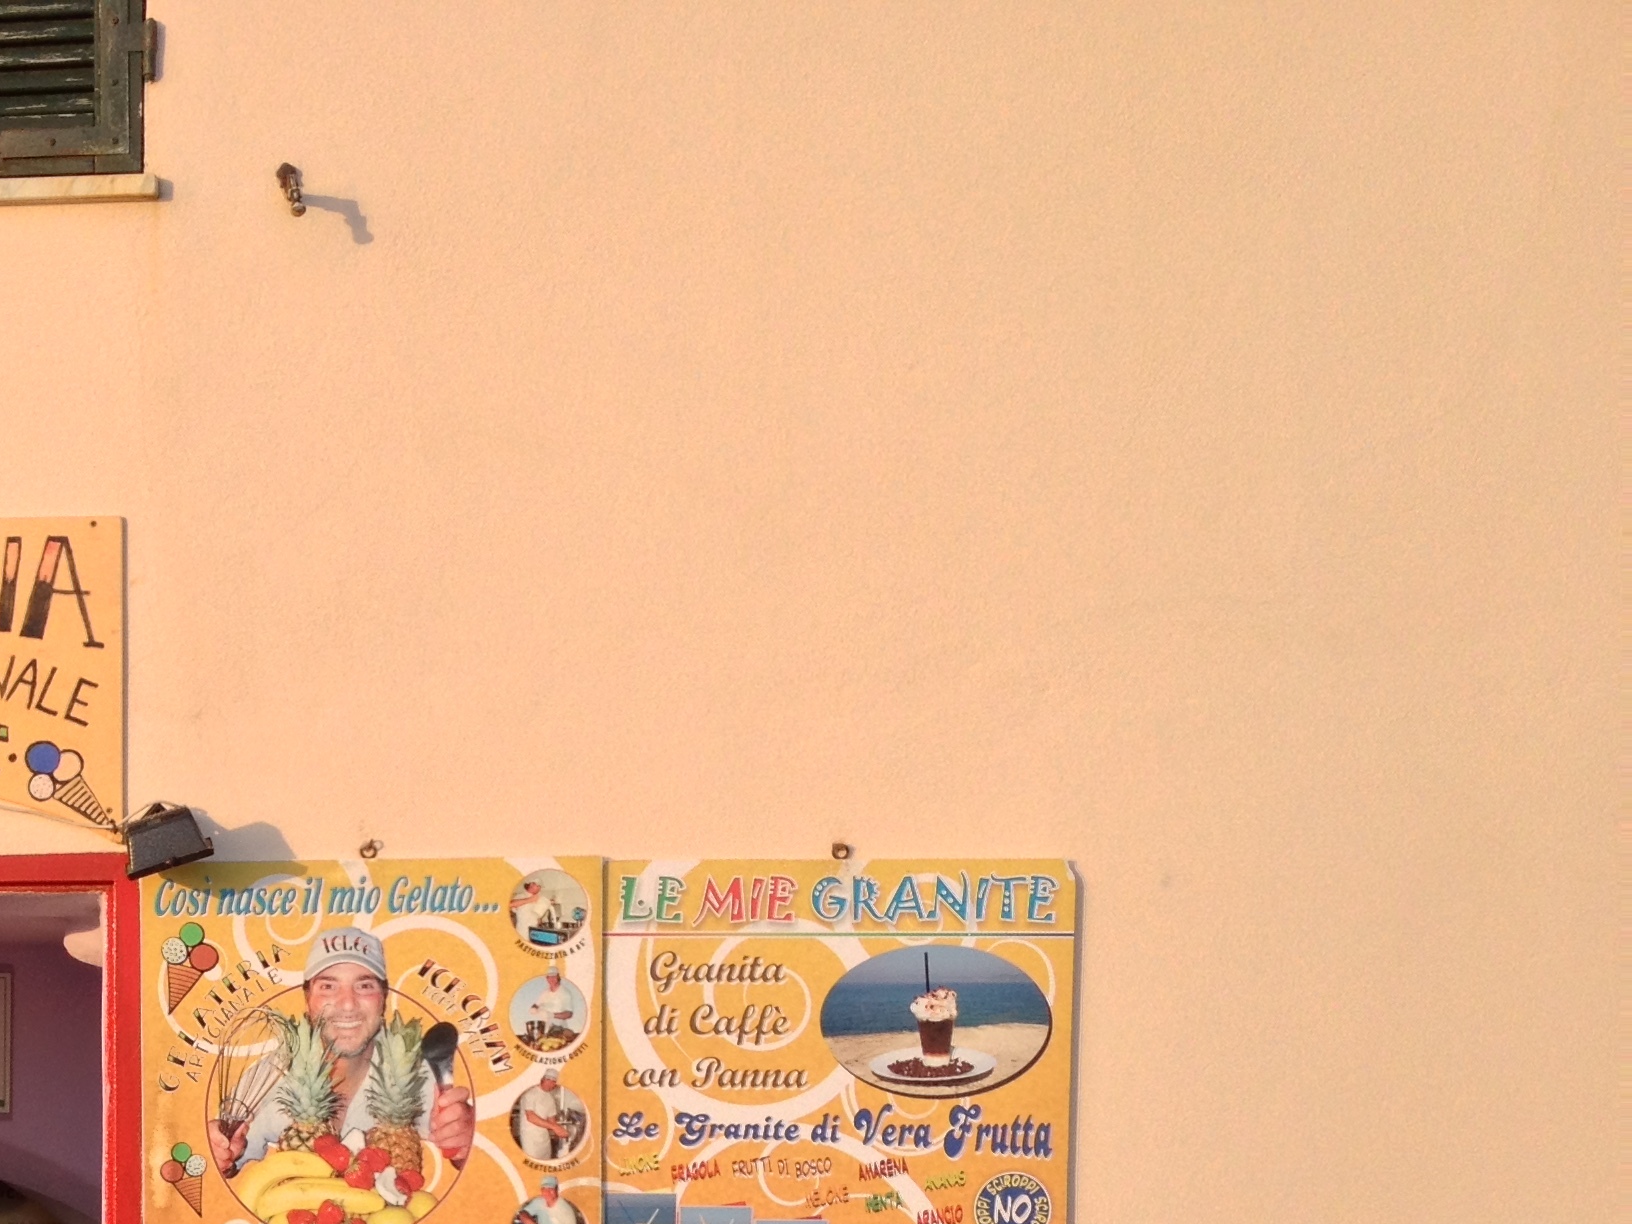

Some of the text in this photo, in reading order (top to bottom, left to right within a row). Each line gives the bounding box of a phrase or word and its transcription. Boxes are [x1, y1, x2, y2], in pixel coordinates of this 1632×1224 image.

[154, 875, 212, 917] Così
[218, 884, 298, 917] nasce
[302, 877, 323, 916] il
[332, 875, 380, 916] mio
[619, 870, 1062, 925] LE MIE GRANITE
[649, 950, 787, 993] Granita
[418, 958, 515, 1075] ICE CREAM
[643, 1003, 791, 1047] di Caffè
[623, 1055, 810, 1091] con Panna
[612, 1103, 1054, 1160] Le Granite di Vera Frutta
[671, 1159, 721, 1184] FRAGOLA
[732, 1155, 774, 1178] FRUTTI
[777, 1158, 791, 1177] DI
[795, 1156, 833, 1179] BOSCO
[858, 1157, 910, 1182] AMARENA
[986, 1174, 1040, 1196] SCIROPPI
[993, 1194, 1032, 1224] NO
